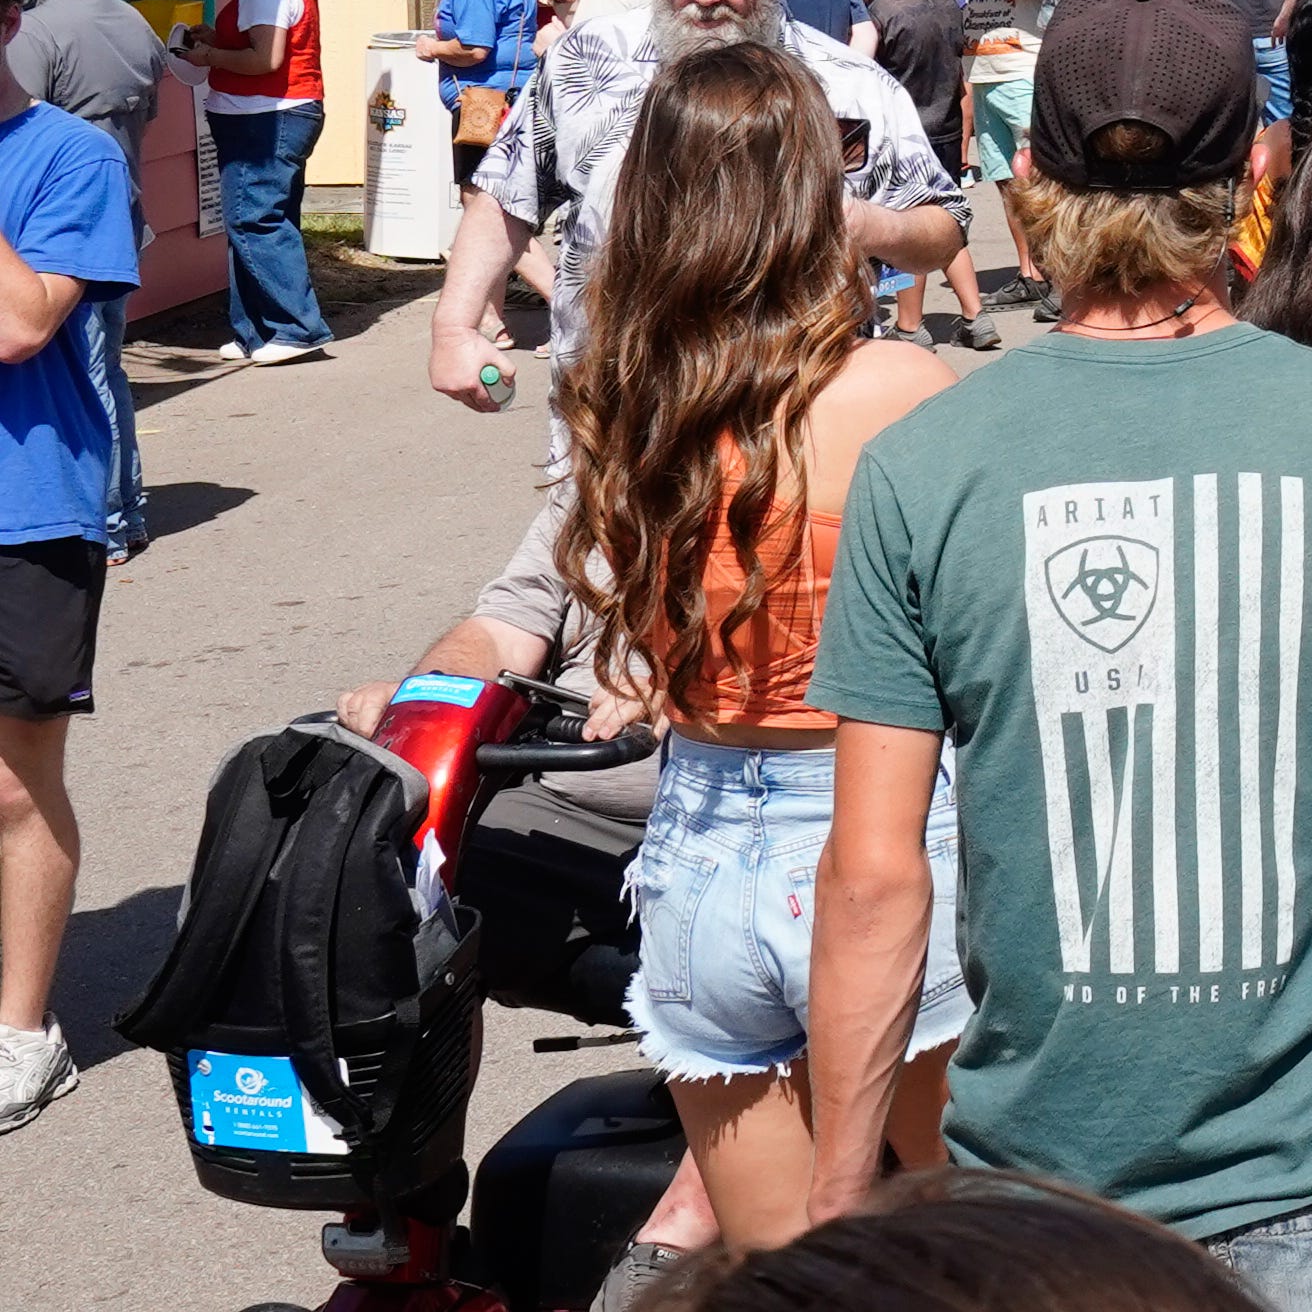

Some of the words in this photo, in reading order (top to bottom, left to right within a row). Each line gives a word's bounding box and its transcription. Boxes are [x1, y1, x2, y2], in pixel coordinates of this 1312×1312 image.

[1036, 494, 1161, 528] ARIAT
[1117, 985, 1147, 1004] OF
[1170, 985, 1219, 1003] THE
[213, 1090, 293, 1109] Scootaround
[225, 1107, 283, 1118] RENTALS
